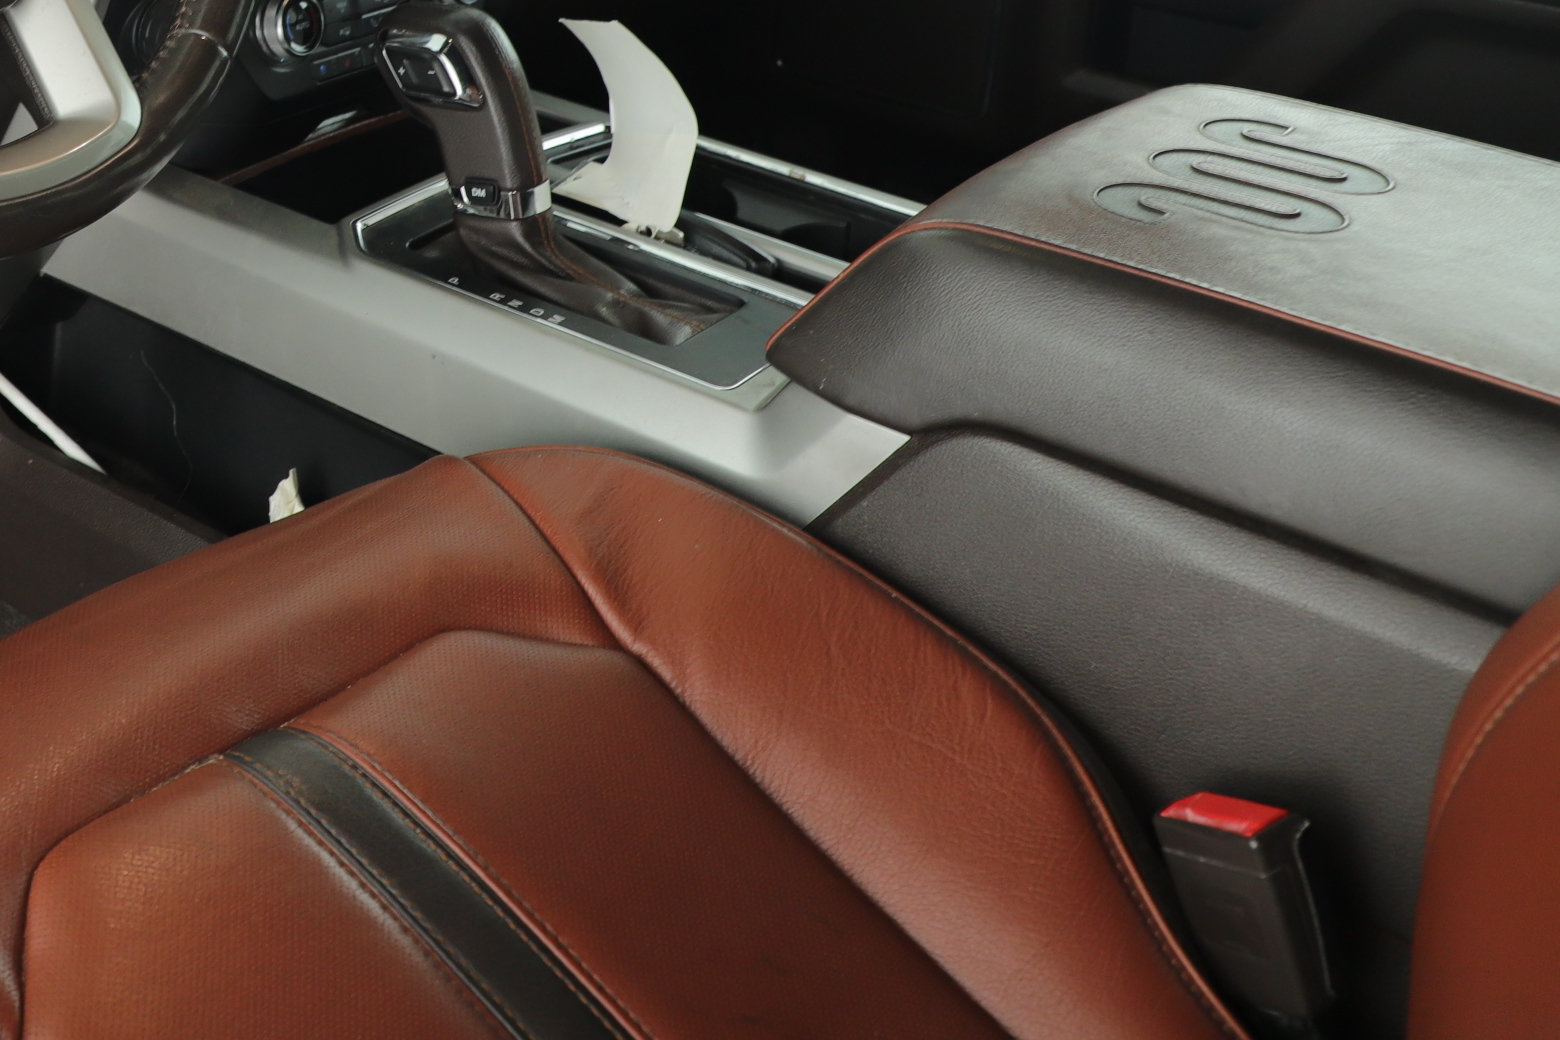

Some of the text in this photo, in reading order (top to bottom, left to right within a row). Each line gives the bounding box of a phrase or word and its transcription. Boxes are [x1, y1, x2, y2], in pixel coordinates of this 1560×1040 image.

[471, 187, 487, 198] DM
[447, 276, 460, 286] P
[489, 291, 507, 302] R
[529, 307, 545, 317] D
